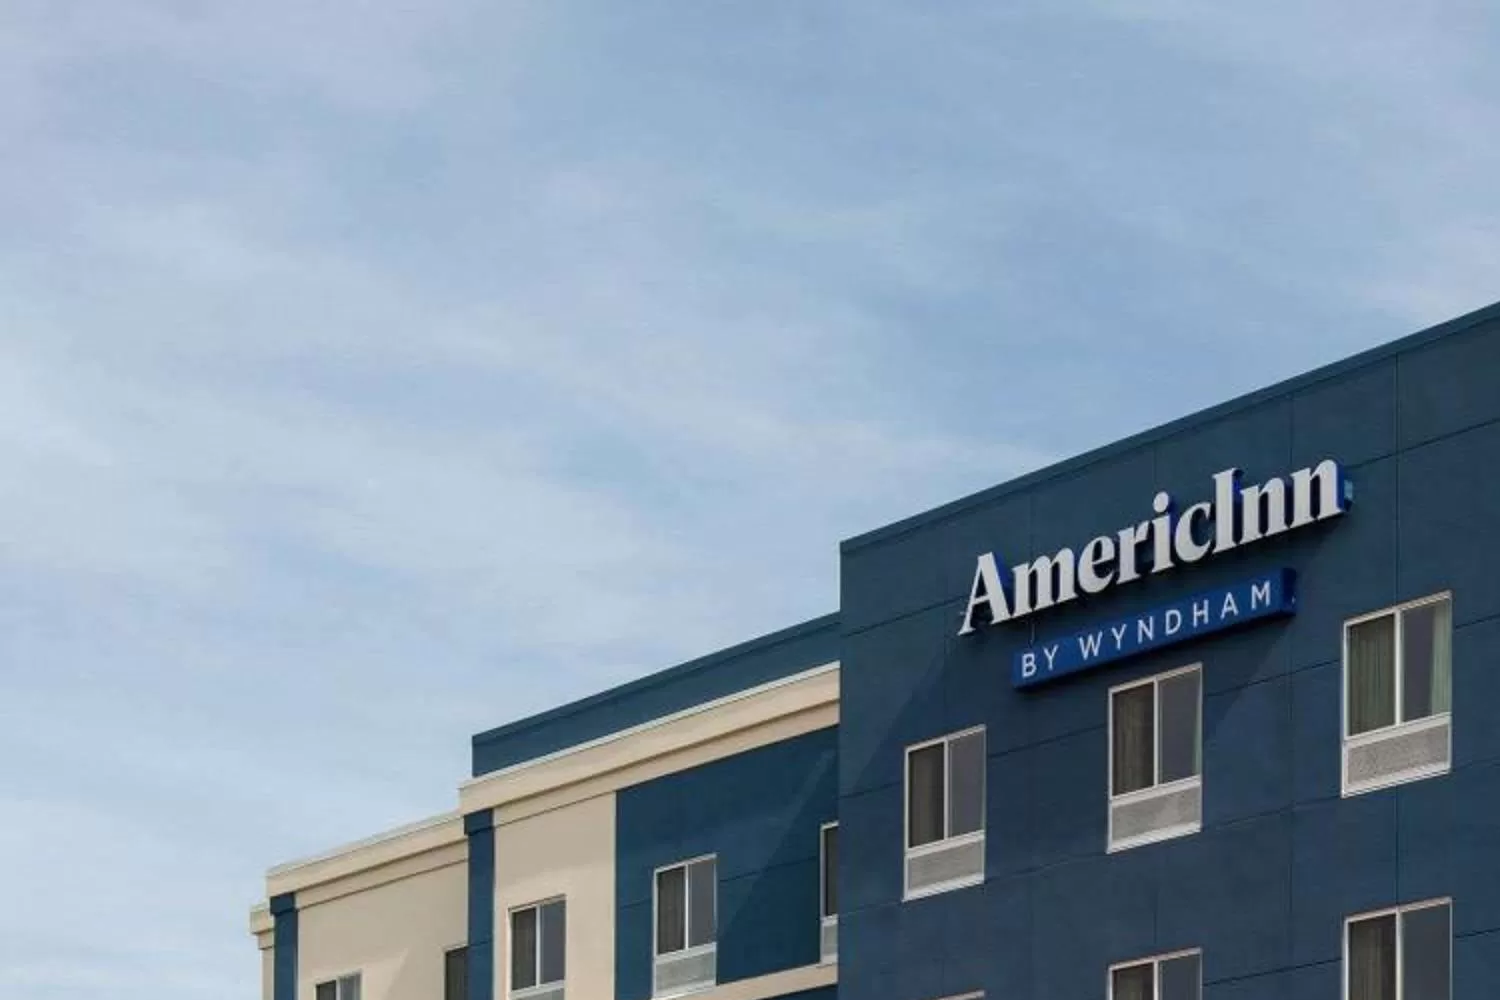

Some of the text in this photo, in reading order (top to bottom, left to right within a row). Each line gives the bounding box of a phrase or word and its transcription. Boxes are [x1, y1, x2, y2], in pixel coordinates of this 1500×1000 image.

[958, 459, 1346, 636] AmericInn
[1021, 580, 1272, 678] BY WYNDHAM
